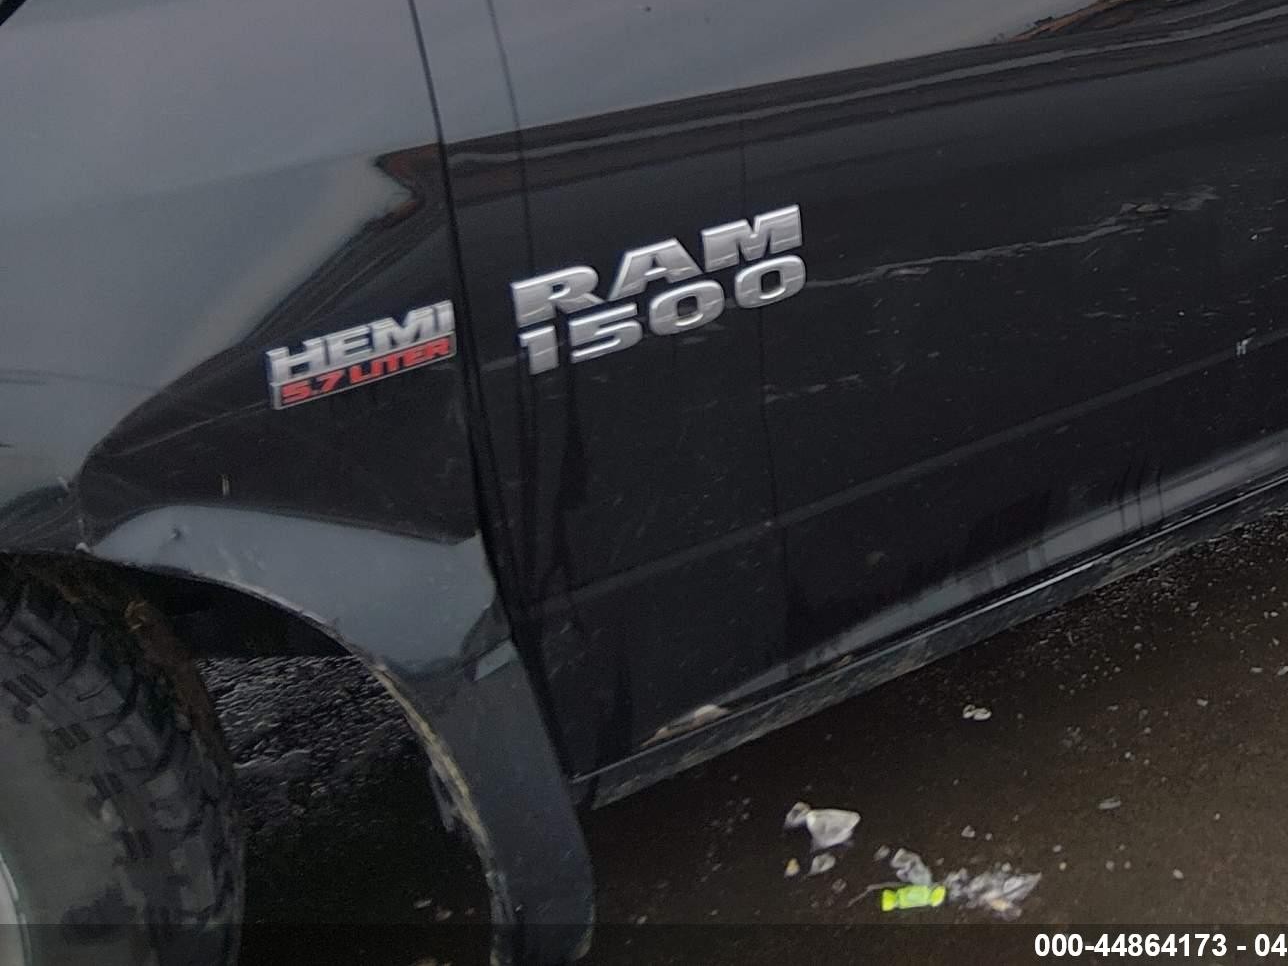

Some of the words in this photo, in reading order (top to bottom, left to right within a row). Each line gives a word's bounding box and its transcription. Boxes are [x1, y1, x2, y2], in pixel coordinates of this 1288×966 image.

[511, 204, 803, 328] RAM
[519, 255, 806, 374] 1500
[265, 300, 456, 383] HEMI
[281, 371, 344, 404] 5.7
[349, 337, 451, 384] LITER
